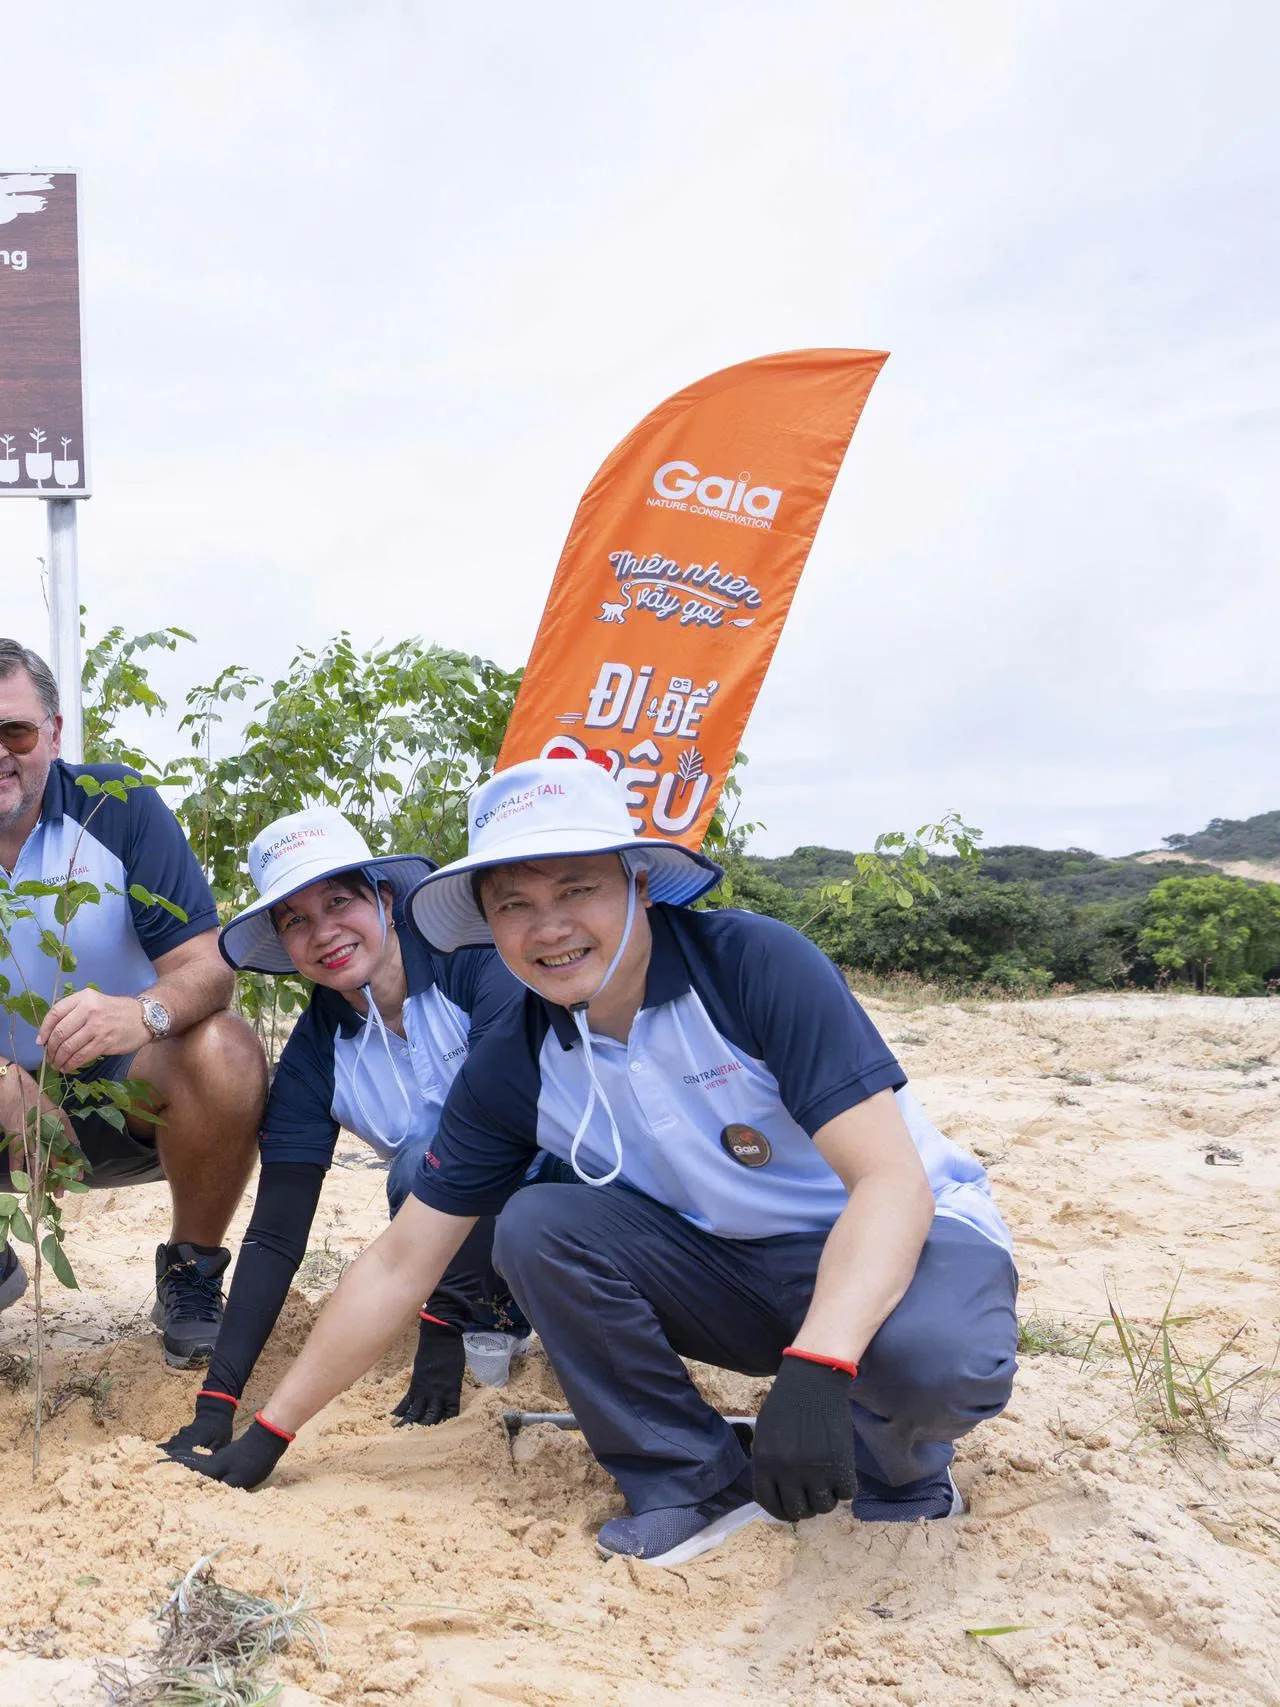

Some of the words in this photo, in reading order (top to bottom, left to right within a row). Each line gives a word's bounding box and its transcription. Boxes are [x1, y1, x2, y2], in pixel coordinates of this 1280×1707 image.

[653, 460, 783, 521] Gaia
[646, 497, 688, 512] NATURE
[689, 502, 773, 530] CONSERVATION
[607, 550, 680, 579] Thiên
[681, 559, 763, 606] nhiên
[635, 584, 681, 617] vẫy
[679, 602, 725, 625] gọi
[495, 801, 534, 823] VIETNAM
[273, 840, 306, 860] VIETNAM
[733, 1144, 761, 1154] Gaia
